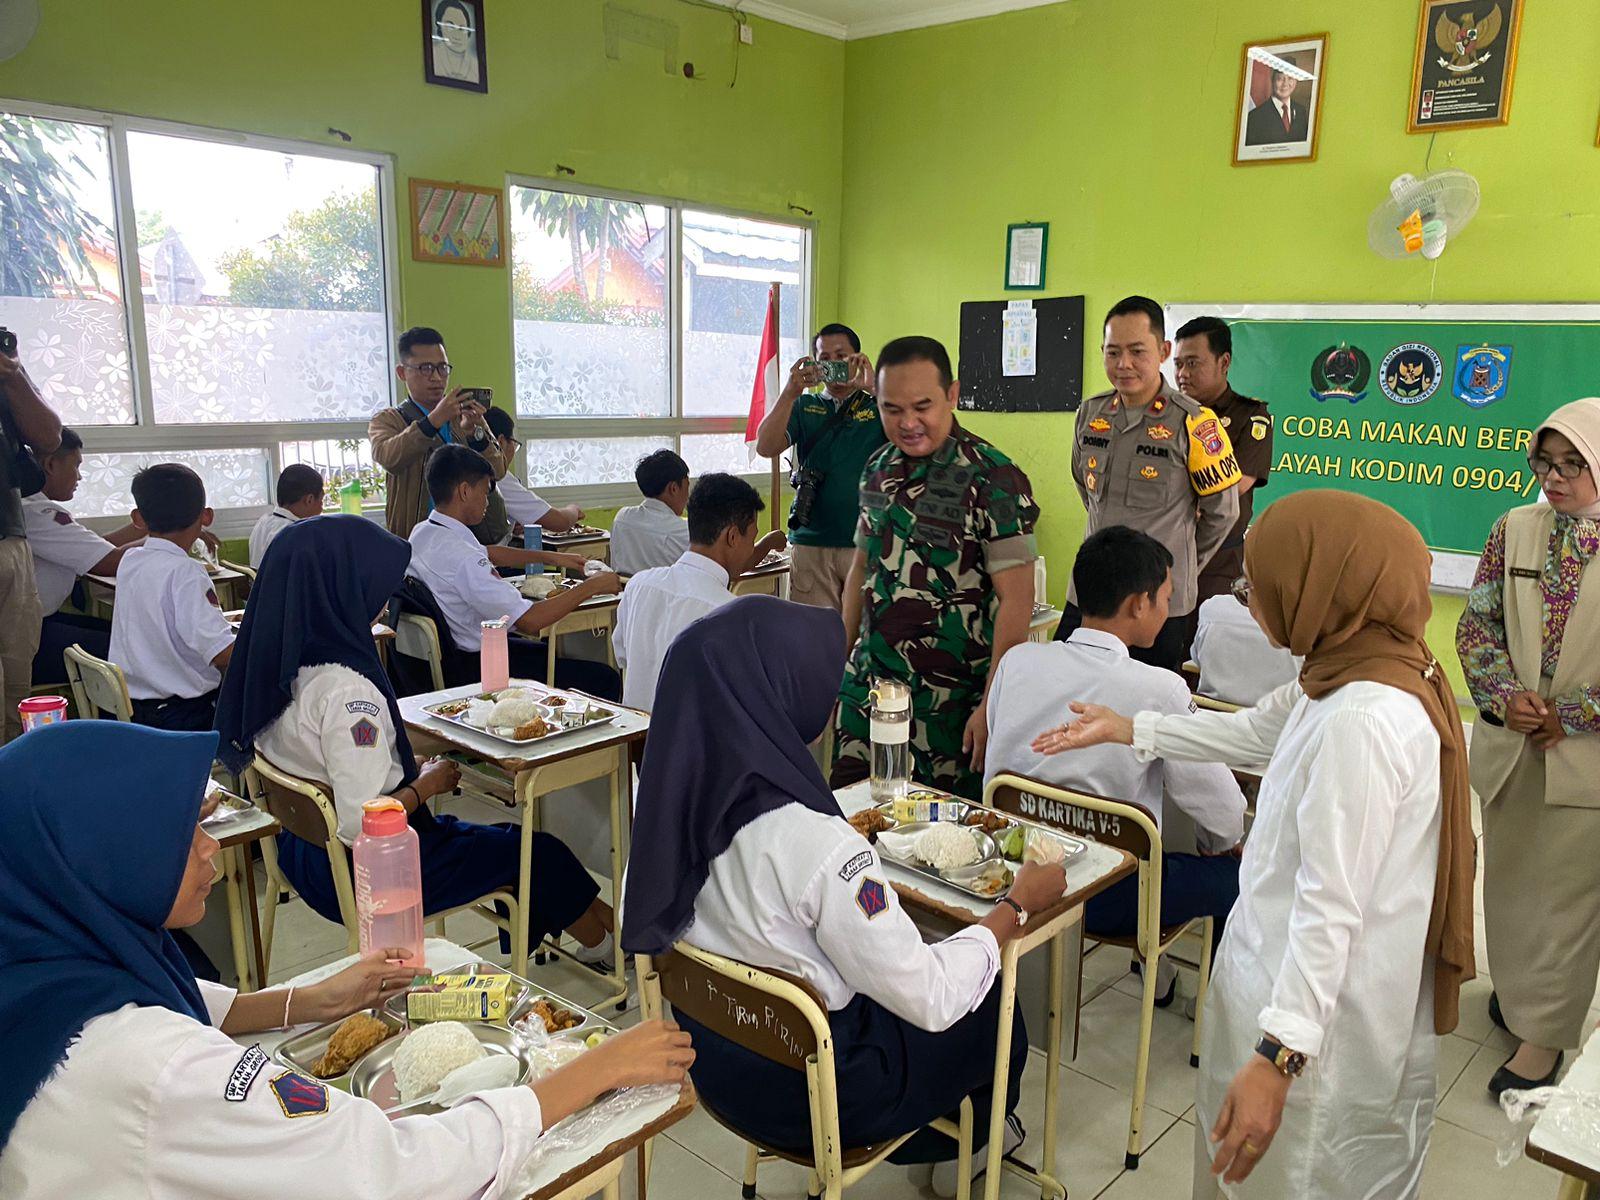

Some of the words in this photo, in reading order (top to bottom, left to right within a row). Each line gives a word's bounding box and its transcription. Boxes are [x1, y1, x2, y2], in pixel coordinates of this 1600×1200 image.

[1438, 76, 1484, 87] PANCASILA
[1406, 382, 1437, 402] INDONESIA
[1083, 435, 1110, 448] DONNY
[1281, 415, 1352, 440] COBA
[1360, 420, 1467, 448] MAKAN
[1136, 444, 1169, 457] POLRI
[1191, 464, 1224, 491] WAKA
[1219, 453, 1238, 478] OPS
[1350, 457, 1443, 486] KODIM
[1452, 465, 1537, 498] 0904/
[1020, 791, 1036, 815] SD
[1038, 797, 1096, 832] KARTIKA
[862, 886, 883, 912] IX
[228, 1082, 238, 1097] SMP
[235, 1072, 252, 1097] TANAH
[288, 1078, 322, 1107] IX
